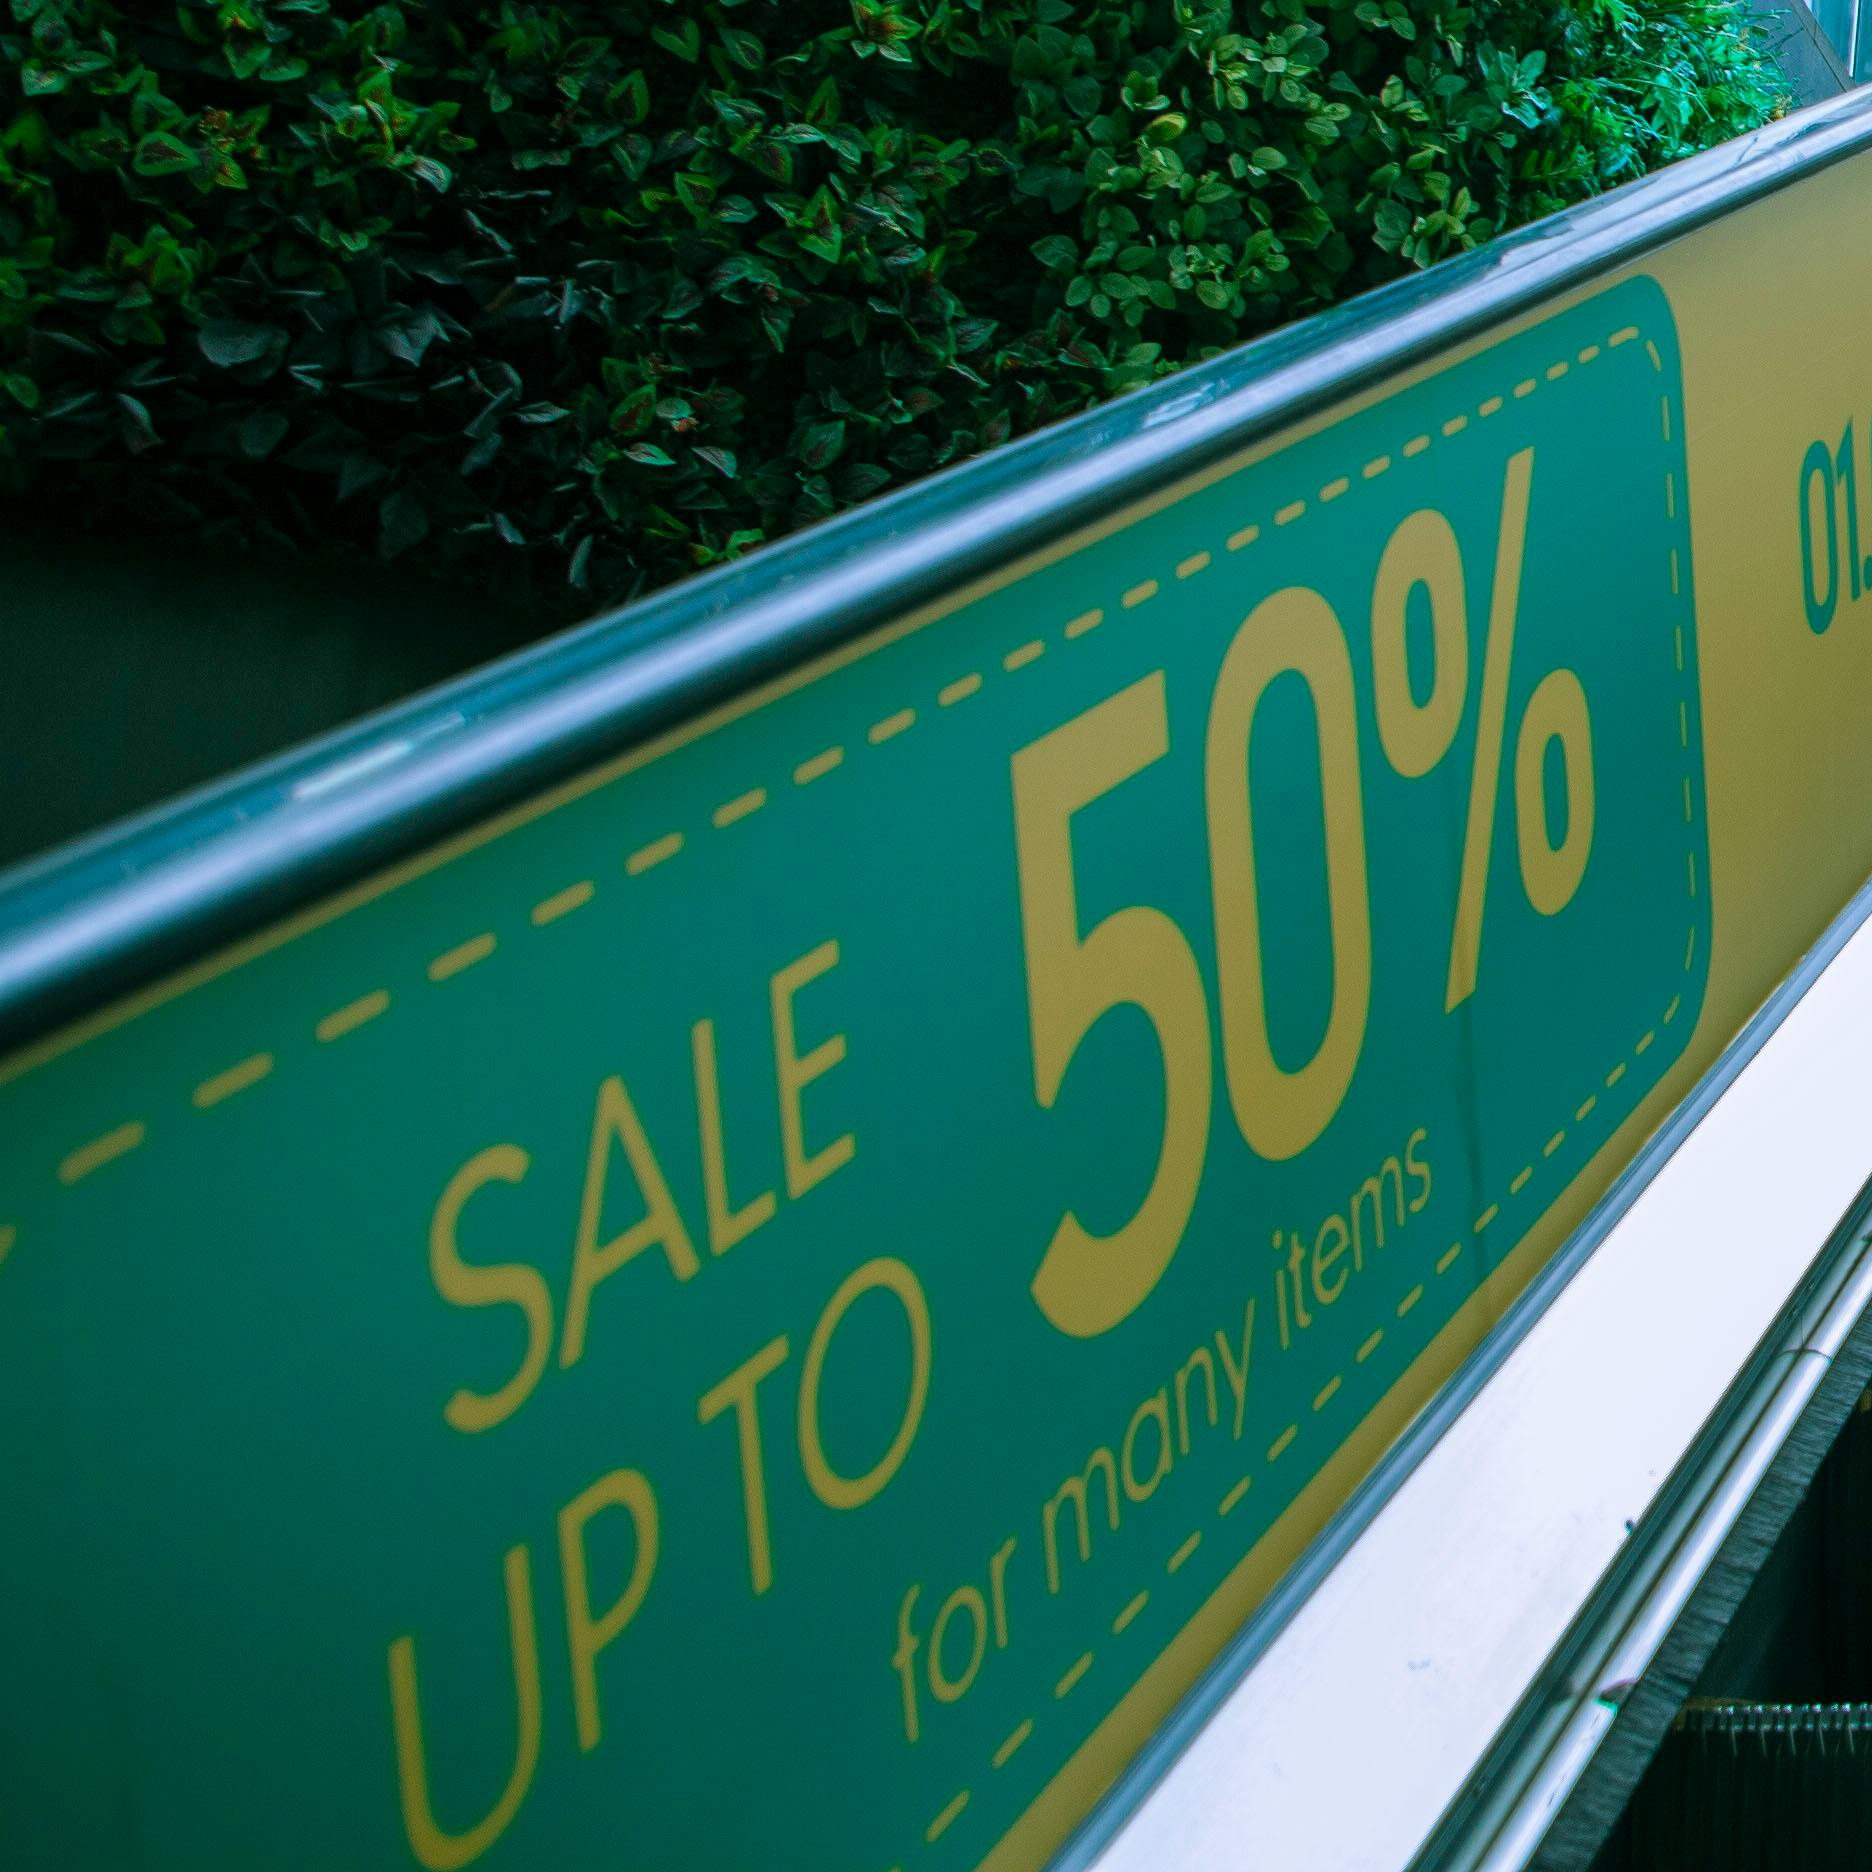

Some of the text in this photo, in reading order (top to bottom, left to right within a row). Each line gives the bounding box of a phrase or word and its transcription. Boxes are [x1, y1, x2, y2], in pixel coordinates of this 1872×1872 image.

[428, 939, 856, 1434] SALE
[1011, 445, 1595, 1338] 50%
[388, 1256, 932, 1872] UP TO
[892, 1127, 1432, 1743] for many items
